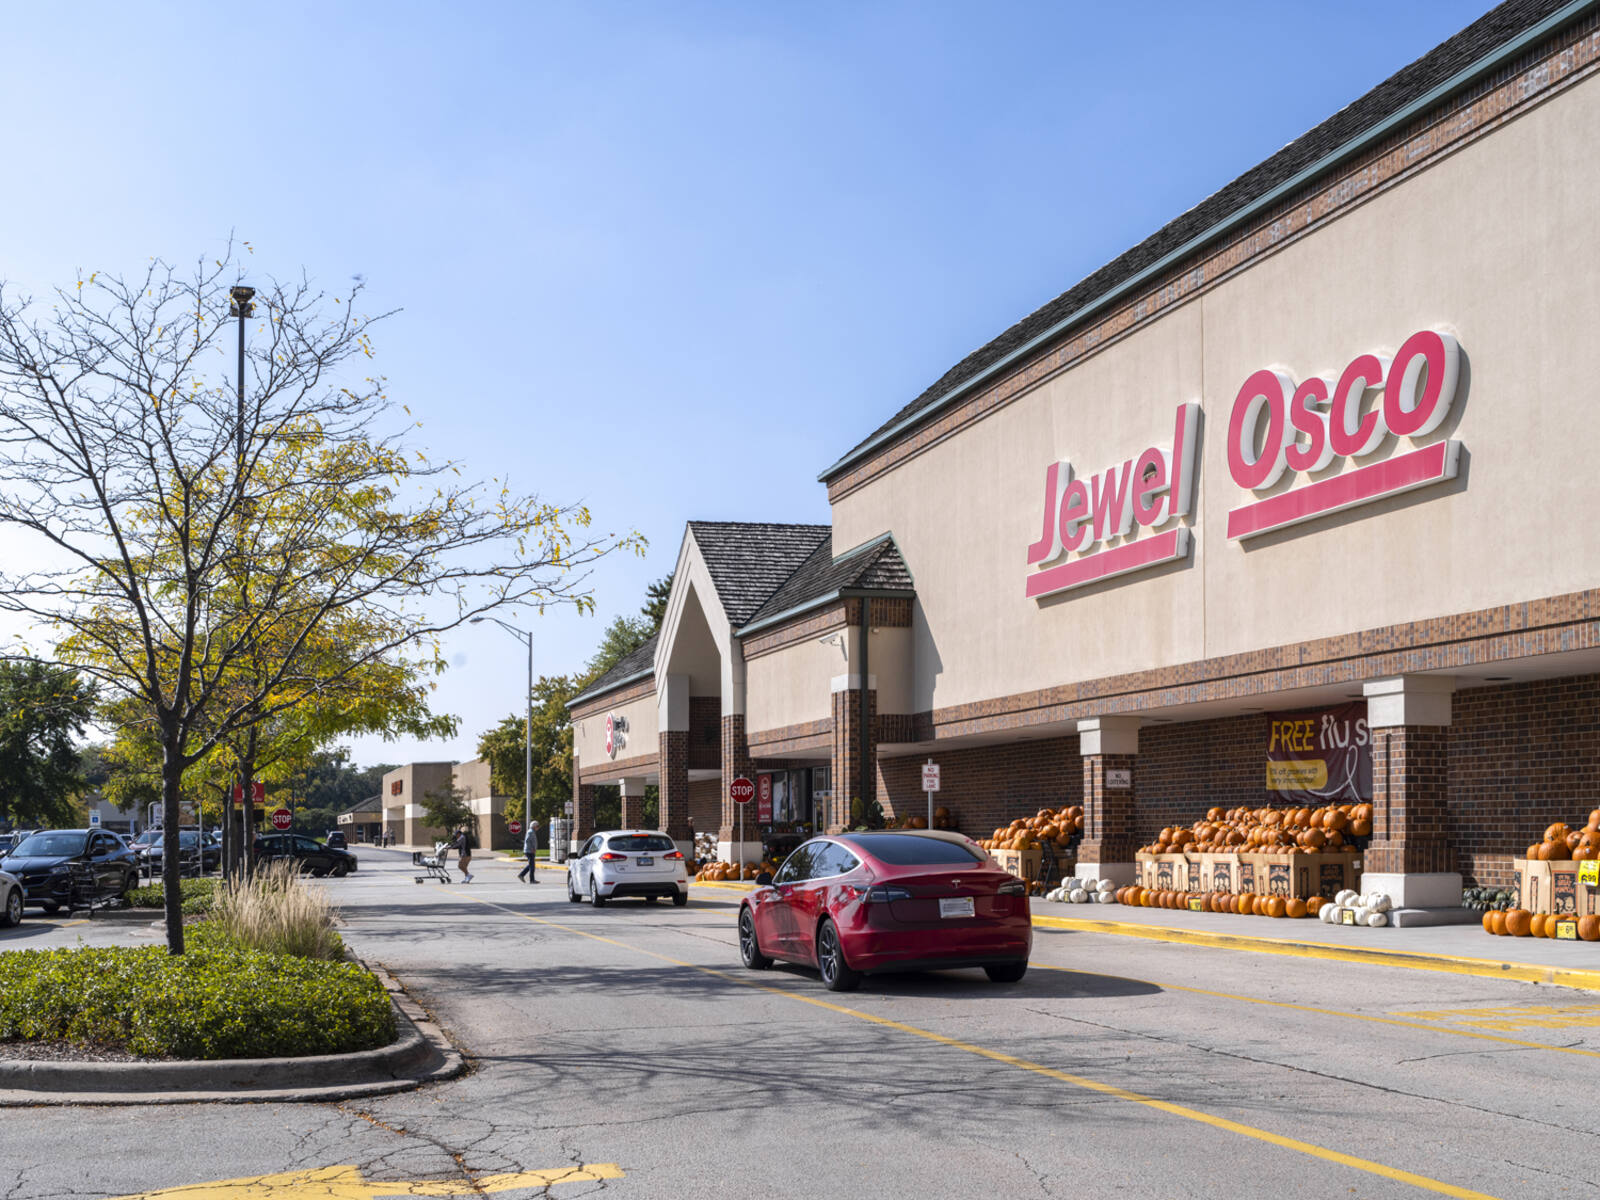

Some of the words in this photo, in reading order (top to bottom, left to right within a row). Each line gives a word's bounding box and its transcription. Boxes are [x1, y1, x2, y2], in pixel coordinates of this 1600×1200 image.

[1027, 403, 1200, 566] Jewel
[1227, 330, 1459, 490] Osco
[1269, 719, 1315, 752] FREE
[731, 785, 753, 796] STOP
[273, 815, 292, 824] STOP
